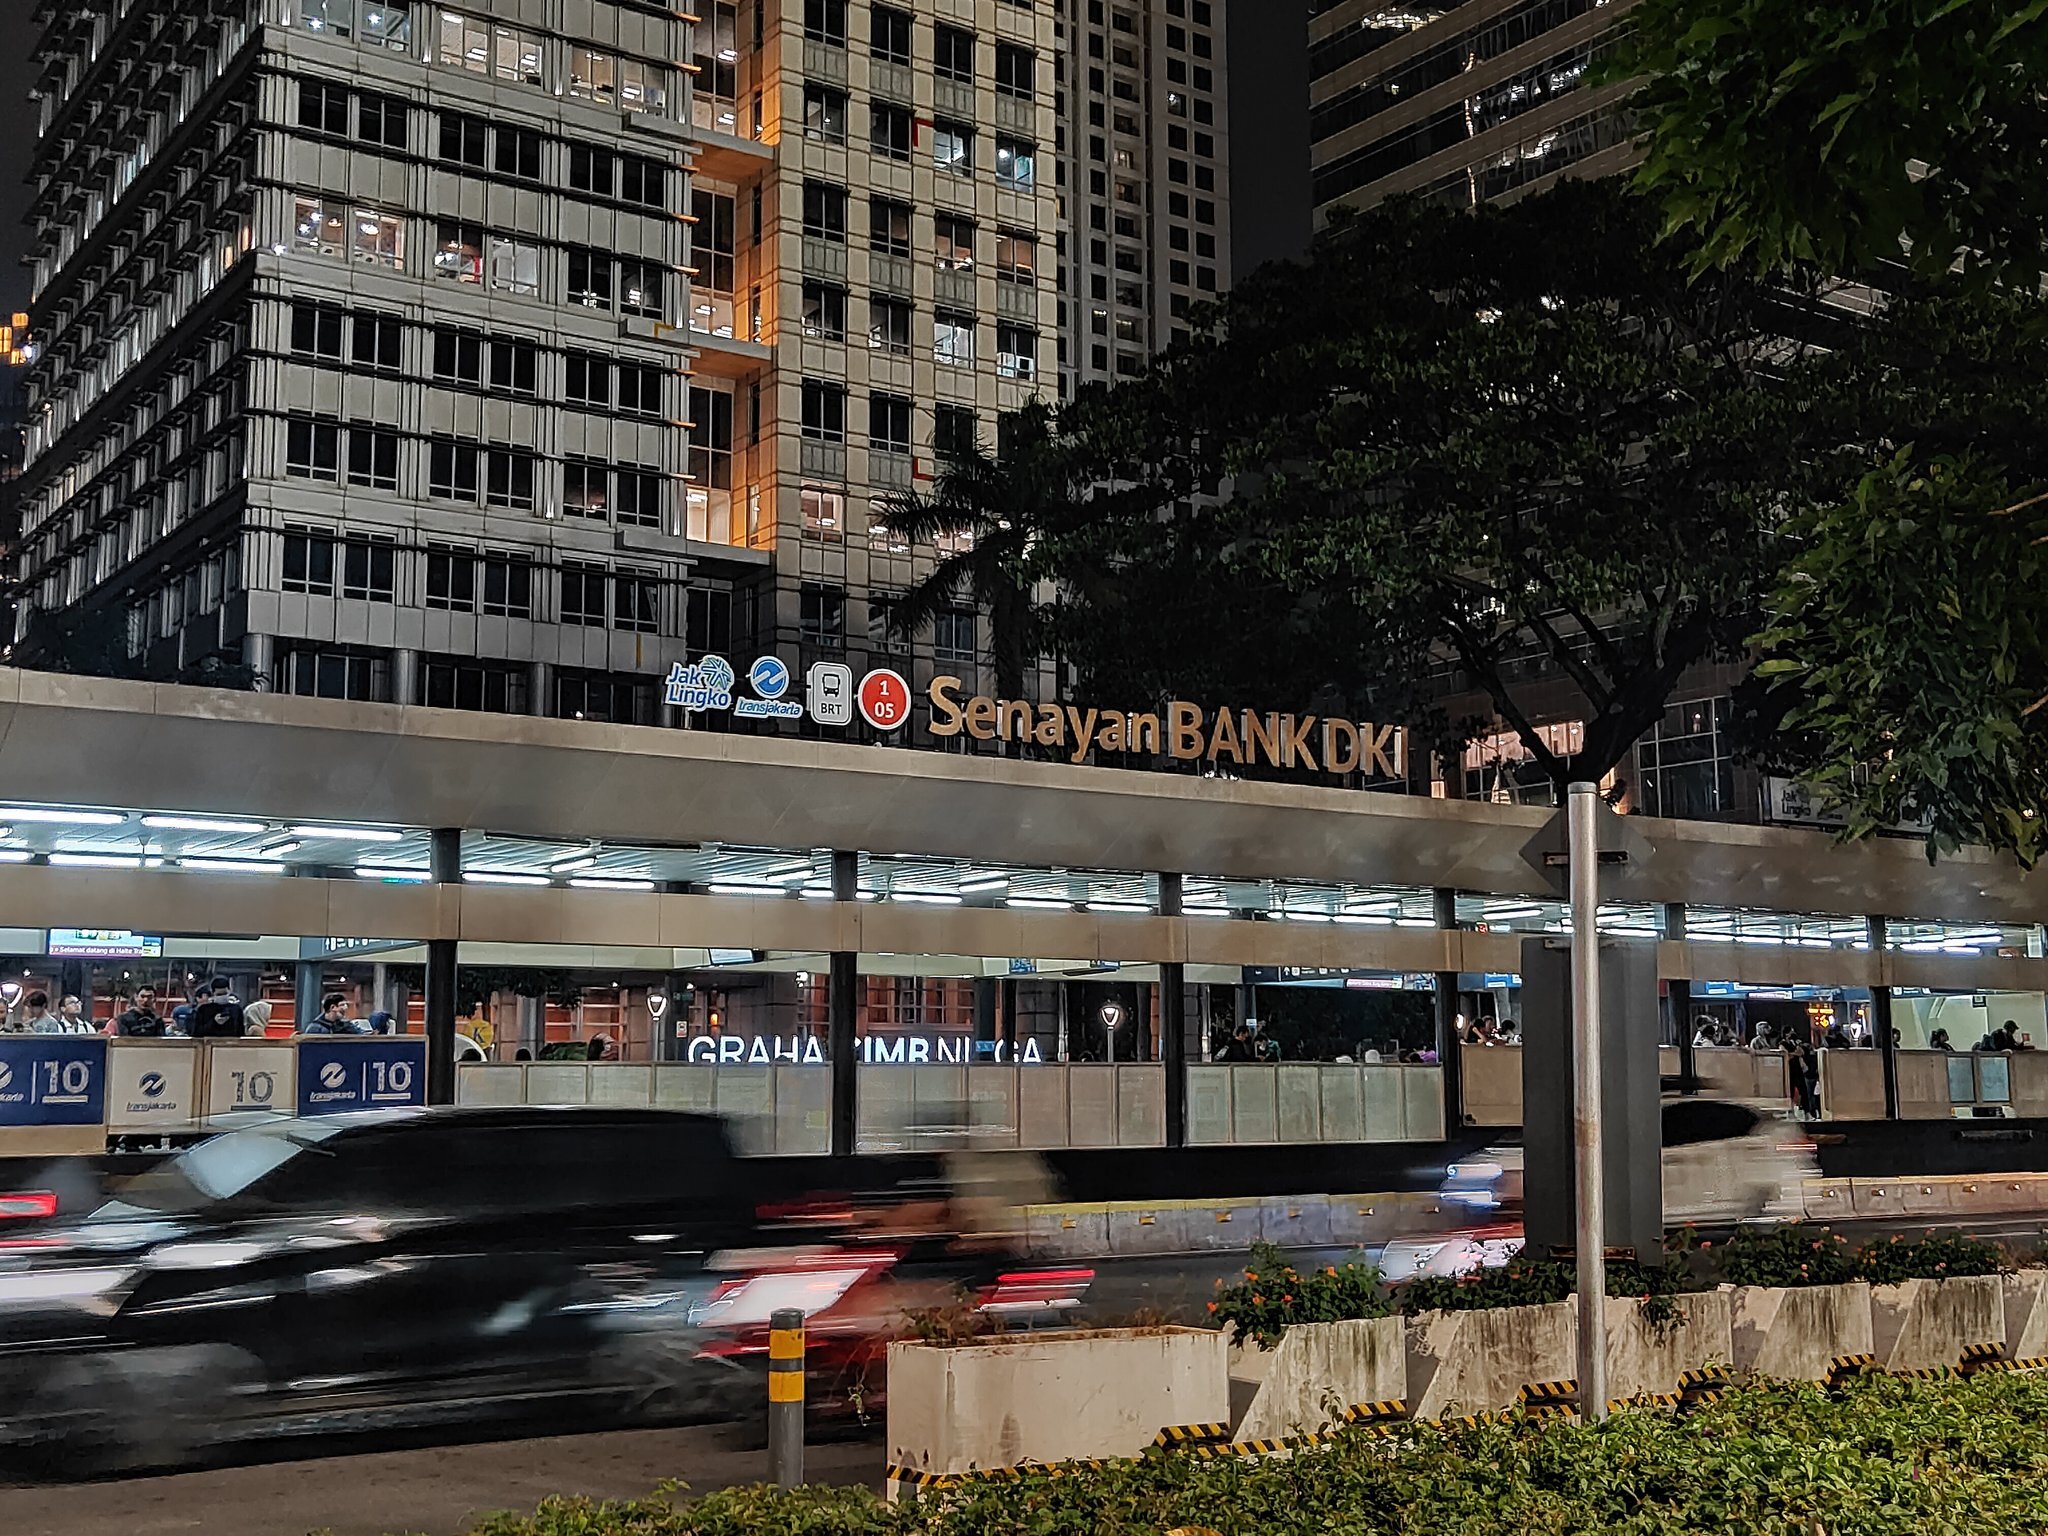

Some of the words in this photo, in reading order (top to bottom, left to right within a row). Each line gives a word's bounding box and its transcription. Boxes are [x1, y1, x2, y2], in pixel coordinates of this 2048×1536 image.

[669, 665, 701, 684] Jak
[669, 684, 728, 708] Lingko
[880, 680, 889, 696] 1
[738, 700, 800, 715] transjakarta
[820, 703, 842, 715] BRT
[874, 702, 894, 718] 05
[929, 675, 1160, 763] Senayan
[1168, 701, 1319, 771] BANK
[1324, 718, 1409, 780] DKI
[86, 947, 107, 955] datang
[688, 1035, 823, 1062] GRAHA
[854, 1036, 930, 1062] IMB
[45, 1061, 89, 1094] 10
[373, 1062, 412, 1091] 10
[231, 1072, 274, 1102] 10
[126, 1102, 176, 1112] transjakarta
